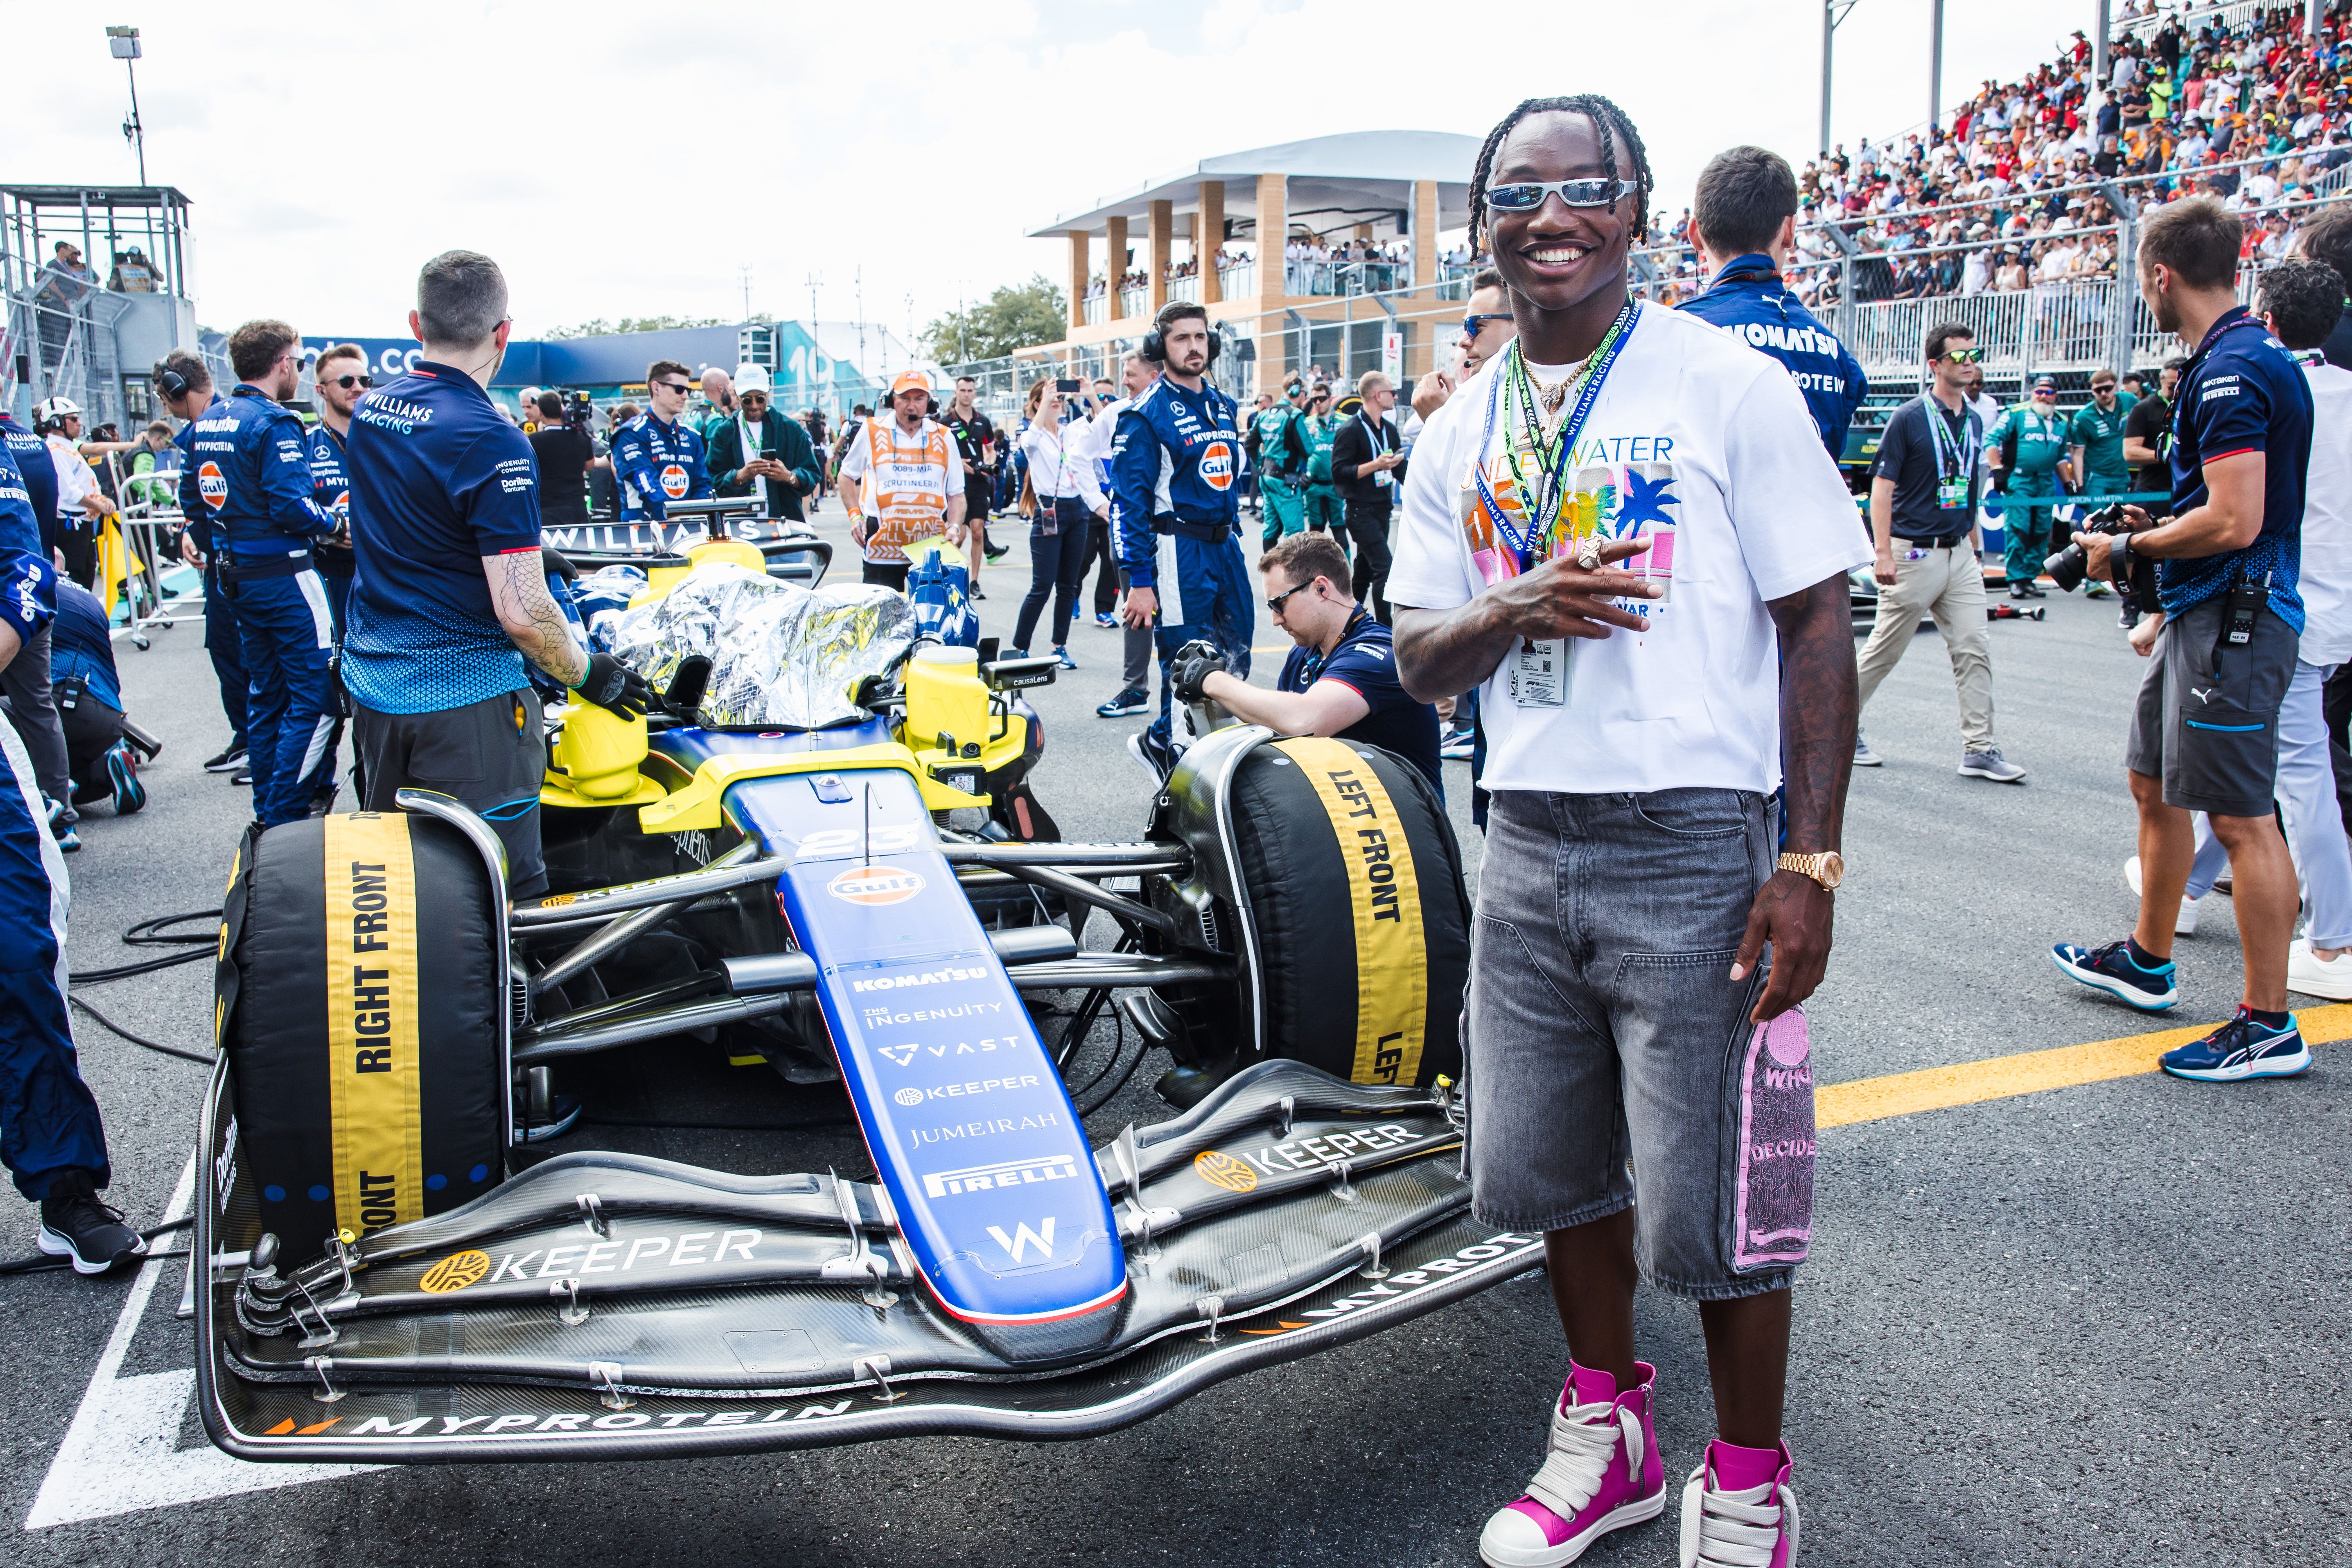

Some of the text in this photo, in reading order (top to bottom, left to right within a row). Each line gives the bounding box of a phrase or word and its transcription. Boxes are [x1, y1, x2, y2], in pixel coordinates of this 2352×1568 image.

[1722, 323, 1838, 359] KOMATSU
[788, 345, 835, 405] 19
[1790, 370, 1844, 395] ROTEIN
[2208, 375, 2239, 386] kraken
[1567, 350, 1616, 435] WILLIAMS RACING
[2202, 386, 2240, 402] PIRELLI
[364, 393, 433, 423] WILLIAMS
[358, 409, 414, 435] RACING
[4, 433, 43, 442] ILLIAMS
[6, 441, 43, 451] RACING
[495, 458, 530, 471] INGENUITY
[501, 466, 530, 474] COMMERCE
[201, 479, 226, 492] Gulf
[662, 476, 686, 486] Gulf
[1475, 476, 1524, 550] WILLIAMS RACING
[1540, 514, 1553, 531] GRID
[876, 532, 901, 543] ALL
[880, 519, 944, 533] PITLANE
[1013, 675, 1048, 686] causaLens
[1327, 770, 1401, 923] LEFT FRONT
[834, 875, 922, 895] Gulf
[352, 861, 388, 954] FRONT
[852, 967, 988, 993] KOMATSU
[354, 965, 392, 1074] RIGHT
[863, 1007, 889, 1015] THG
[865, 1002, 1002, 1030] INGENUITY
[928, 1036, 1019, 1058] VAST
[1371, 1031, 1404, 1085] LEF
[927, 1075, 1041, 1100] KEEPER
[1764, 1066, 1811, 1088] WHO
[1241, 1124, 1423, 1176] KEEPER
[1751, 1139, 1816, 1162] DECIDE
[219, 1161, 237, 1215] Ventures
[922, 1154, 1079, 1199] PIRELLI
[359, 1171, 396, 1237] ONT
[489, 1229, 763, 1283] KEEPER
[349, 1400, 853, 1435] MYPROTEIN
